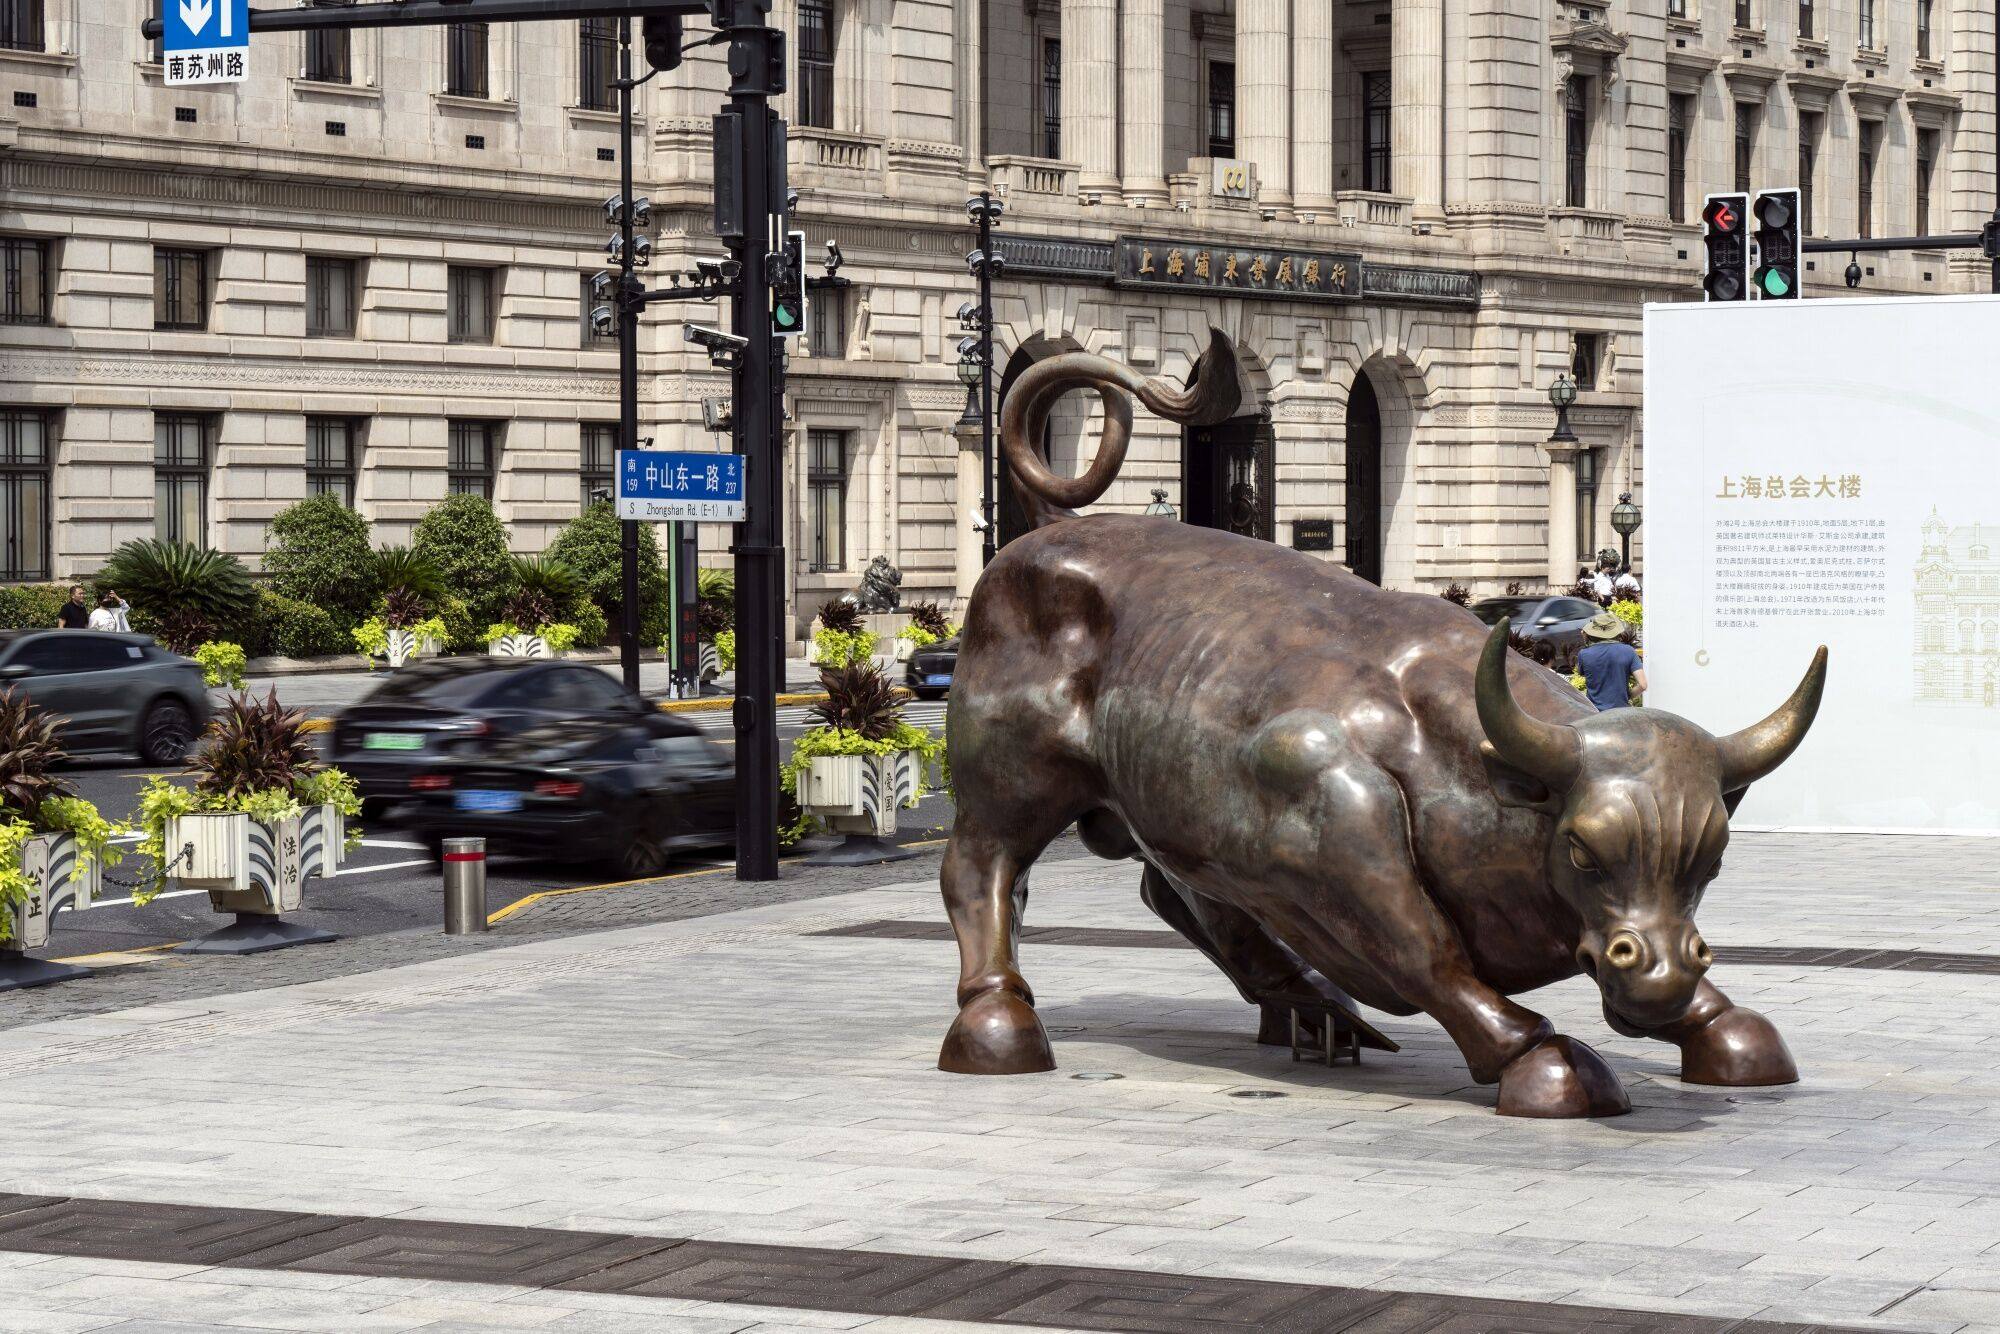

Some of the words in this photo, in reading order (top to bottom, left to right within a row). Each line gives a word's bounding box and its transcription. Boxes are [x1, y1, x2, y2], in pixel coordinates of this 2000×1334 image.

[169, 52, 244, 80] 南苏州路
[627, 458, 636, 473] 南
[727, 463, 736, 477] 北
[645, 460, 720, 492] 中山东一路
[626, 478, 638, 492] 159
[725, 482, 737, 494] 237
[1715, 474, 1862, 499] 上海总会大楼
[629, 502, 635, 515] S
[646, 502, 684, 518] Zhongshan
[687, 504, 698, 516] Rd.
[700, 504, 719, 518] (E-1)
[727, 505, 733, 517] N
[282, 836, 298, 885] 法治
[27, 866, 46, 919] 公正
